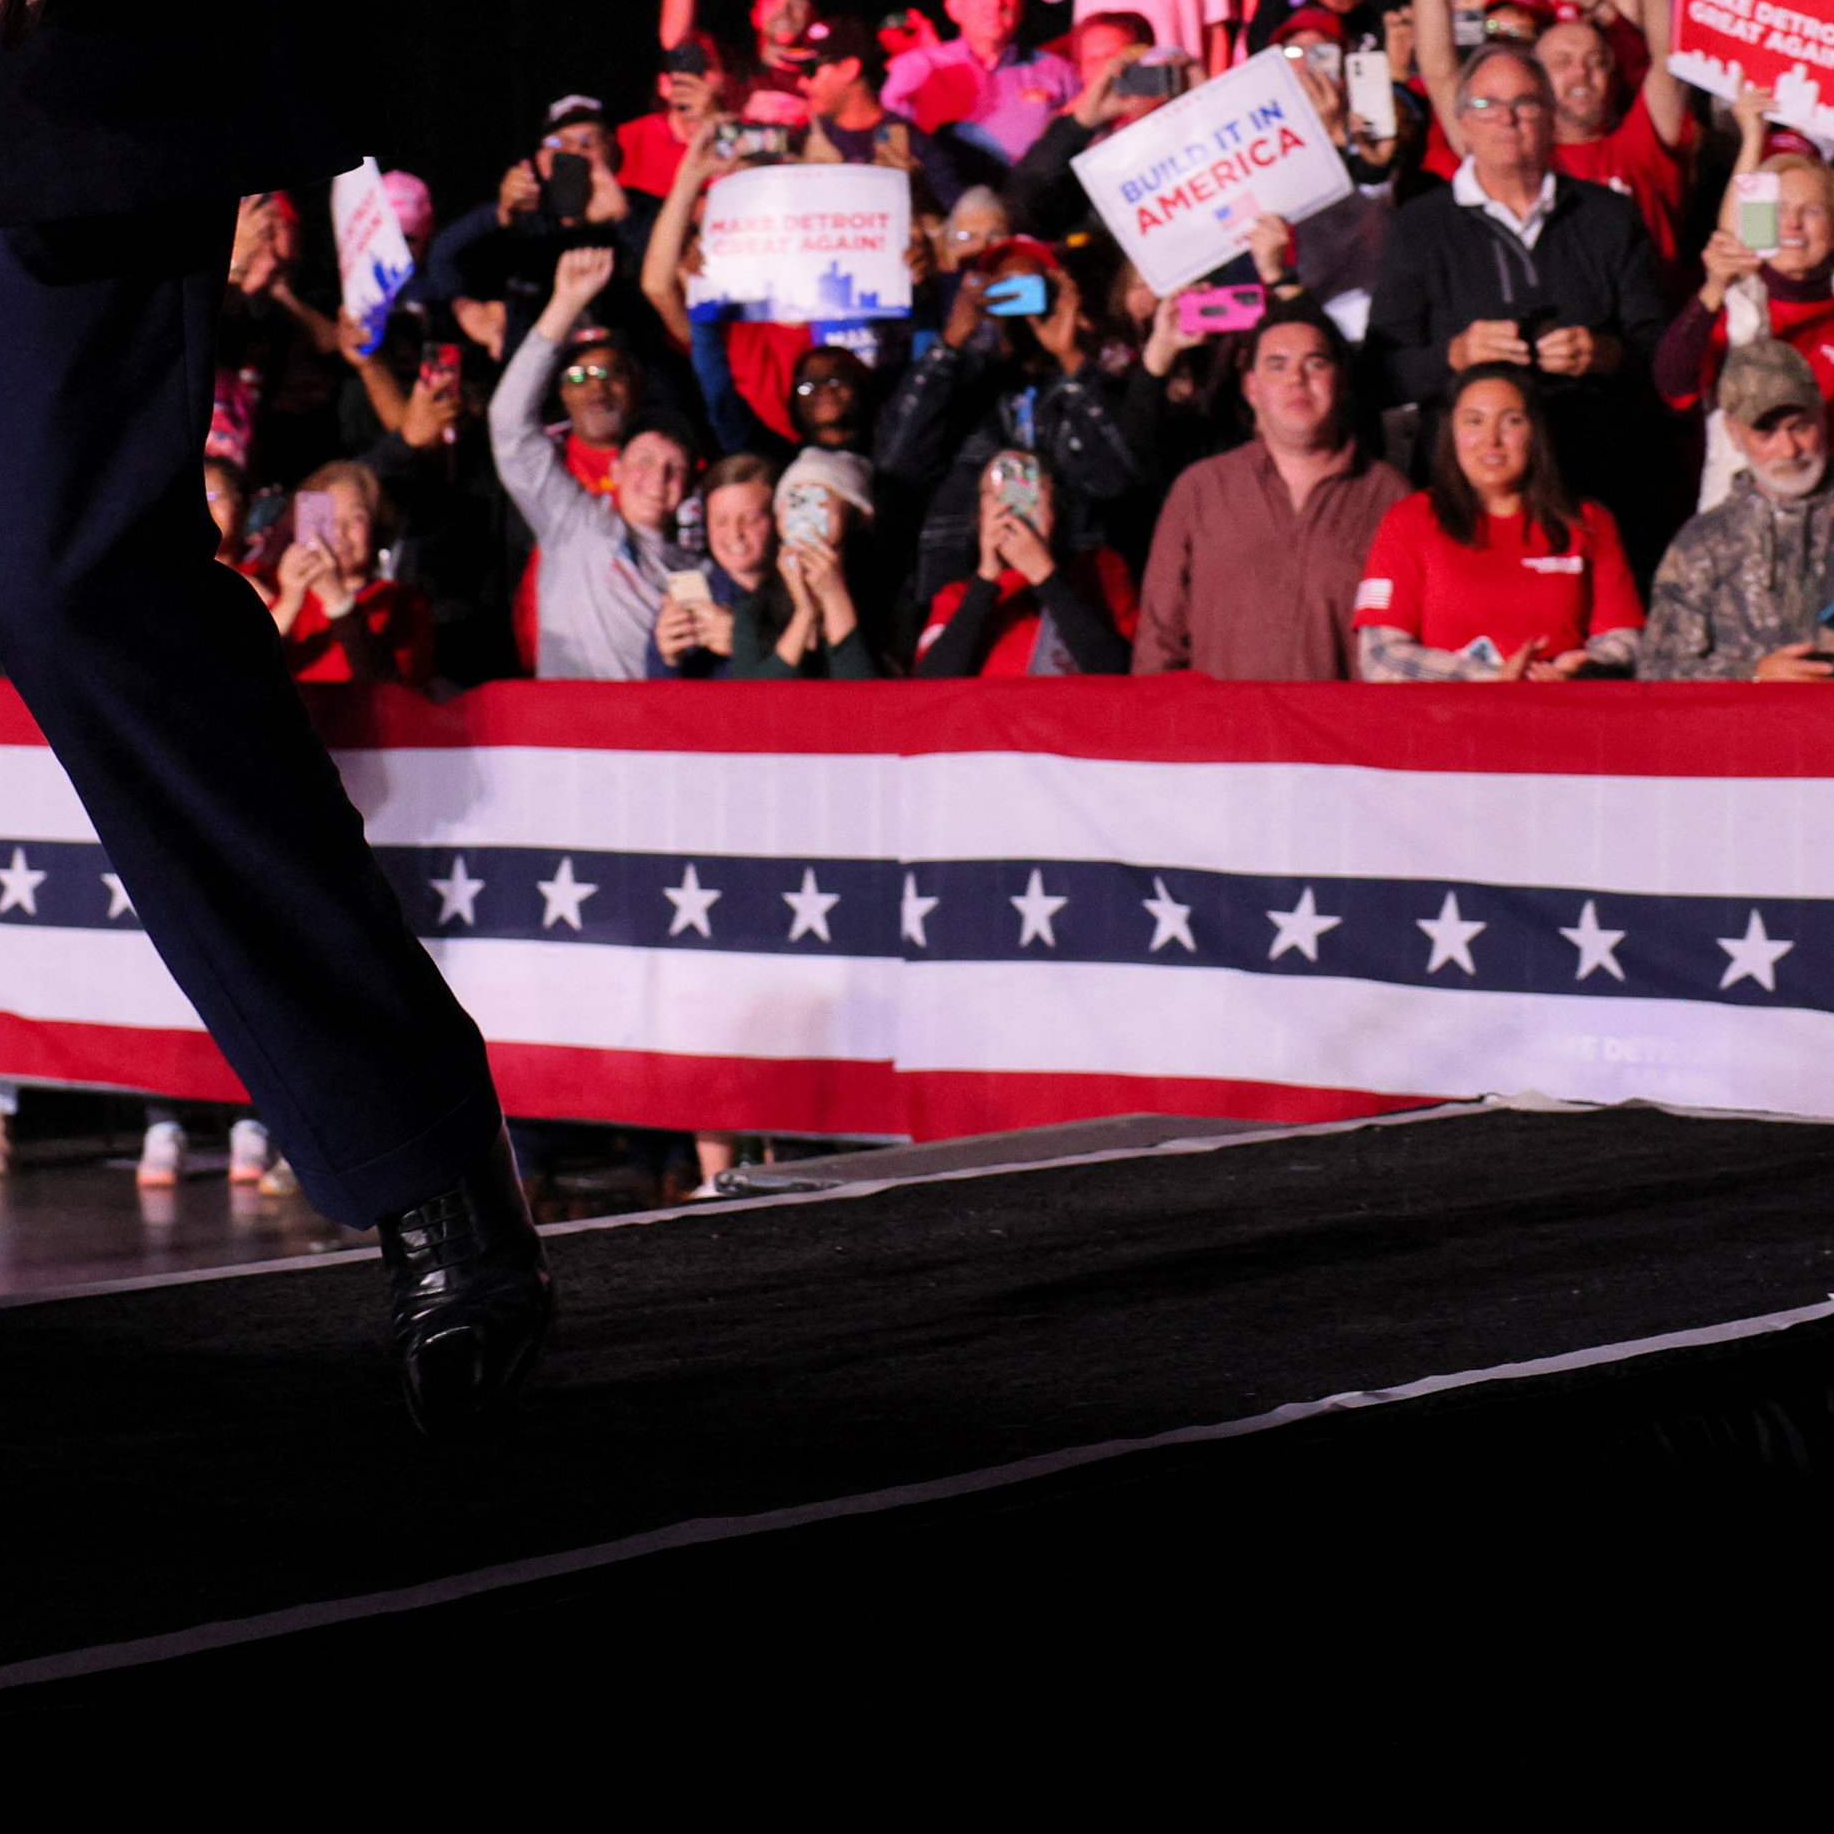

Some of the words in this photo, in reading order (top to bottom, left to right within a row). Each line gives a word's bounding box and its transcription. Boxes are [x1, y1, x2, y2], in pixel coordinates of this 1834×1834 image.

[1688, 0, 1765, 45] GREAT
[1119, 142, 1210, 205] BUILD
[1213, 119, 1243, 151] IT
[1248, 98, 1285, 132] IN
[1135, 126, 1307, 236] AMERICA
[783, 212, 890, 232] DETROIT
